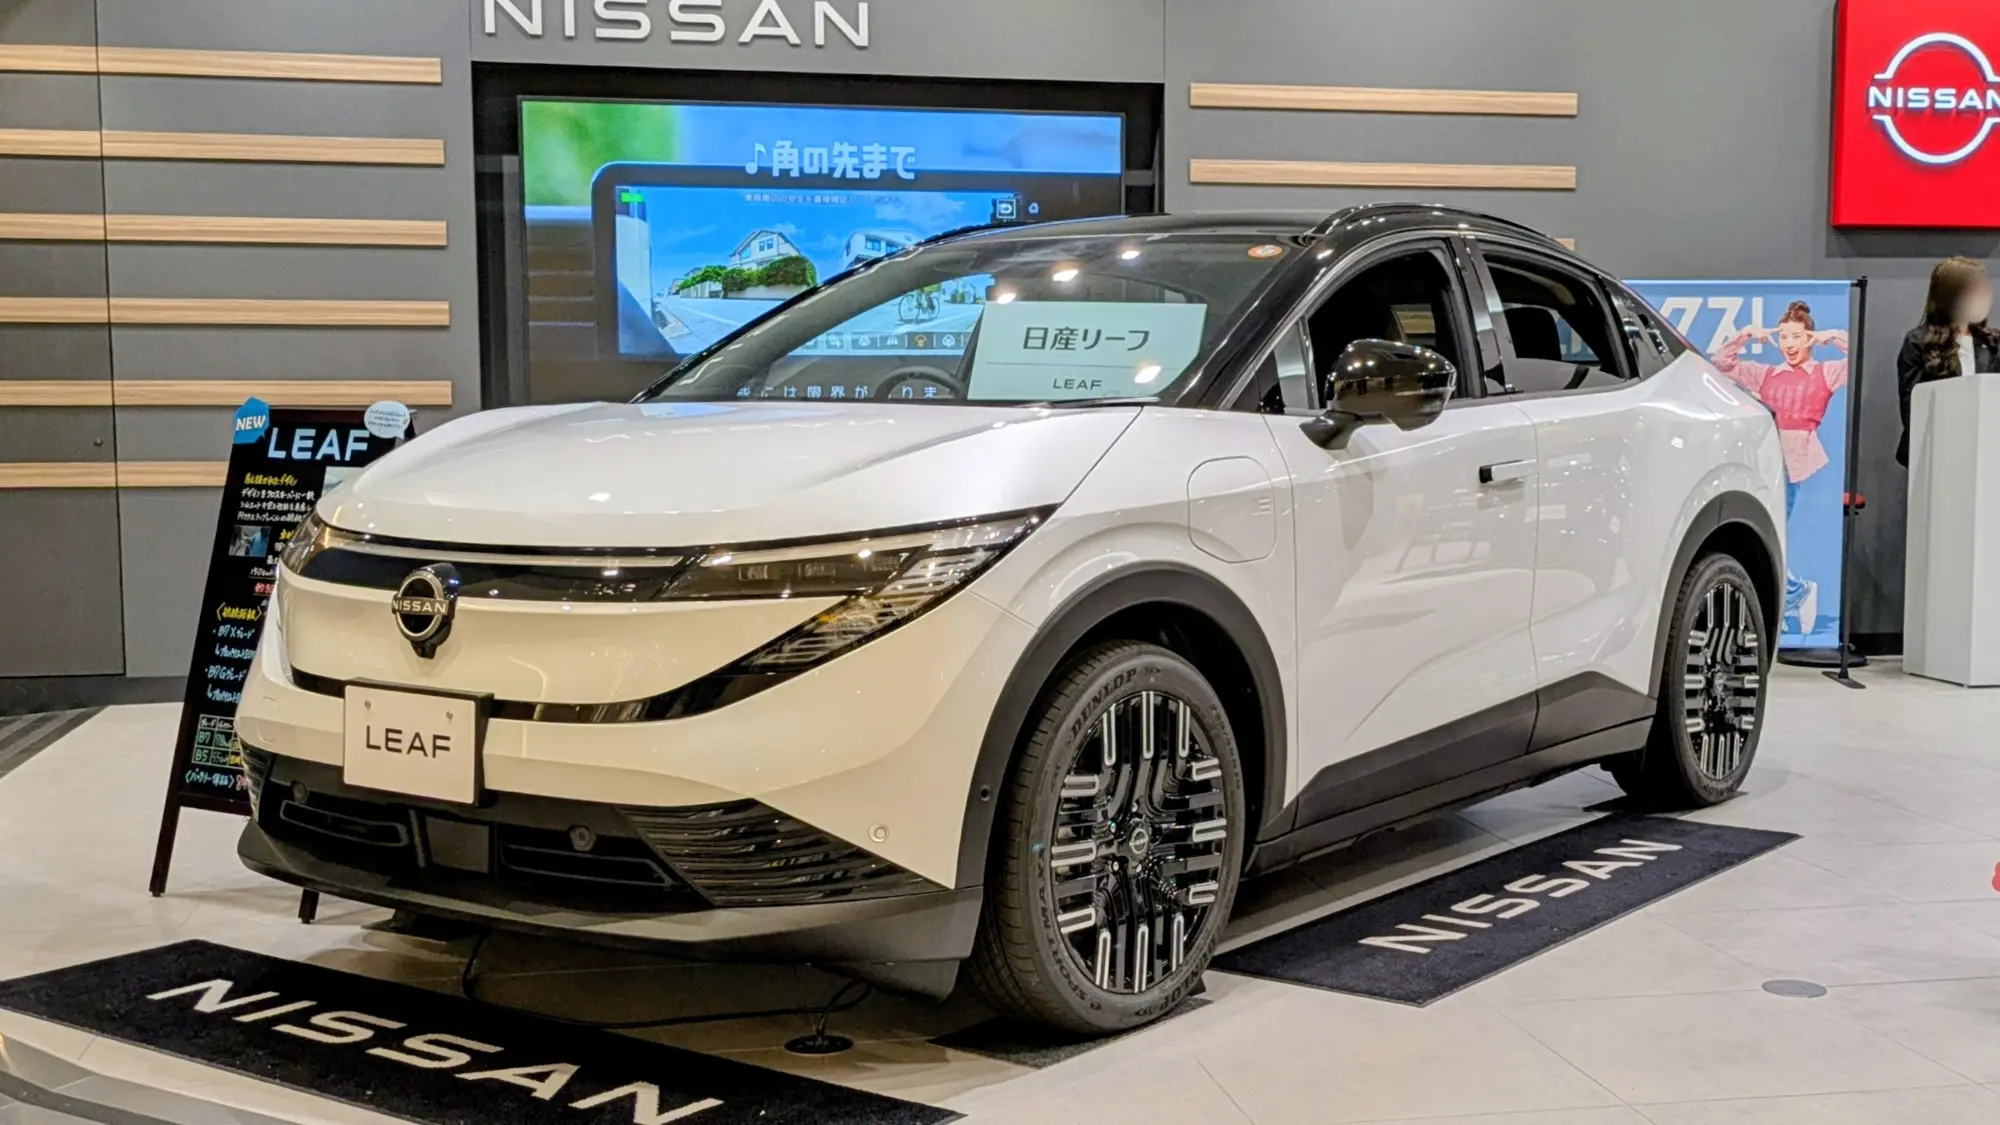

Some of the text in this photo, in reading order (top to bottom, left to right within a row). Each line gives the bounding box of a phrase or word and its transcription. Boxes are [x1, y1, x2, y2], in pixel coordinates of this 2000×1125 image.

[484, 0, 869, 47] NISSAN
[1868, 87, 2000, 109] NISSAN
[772, 140, 916, 180] 角の先まで
[1023, 326, 1150, 351] 日産リーフ
[1053, 378, 1102, 390] LEAF
[236, 415, 266, 431] NEW
[267, 427, 370, 461] LEAF
[393, 600, 447, 613] NISSAN
[1070, 668, 1138, 736] DUNLOP
[366, 725, 451, 759] LEAF
[1358, 838, 1683, 954] NISSAN
[147, 978, 724, 1125] NISSAN
